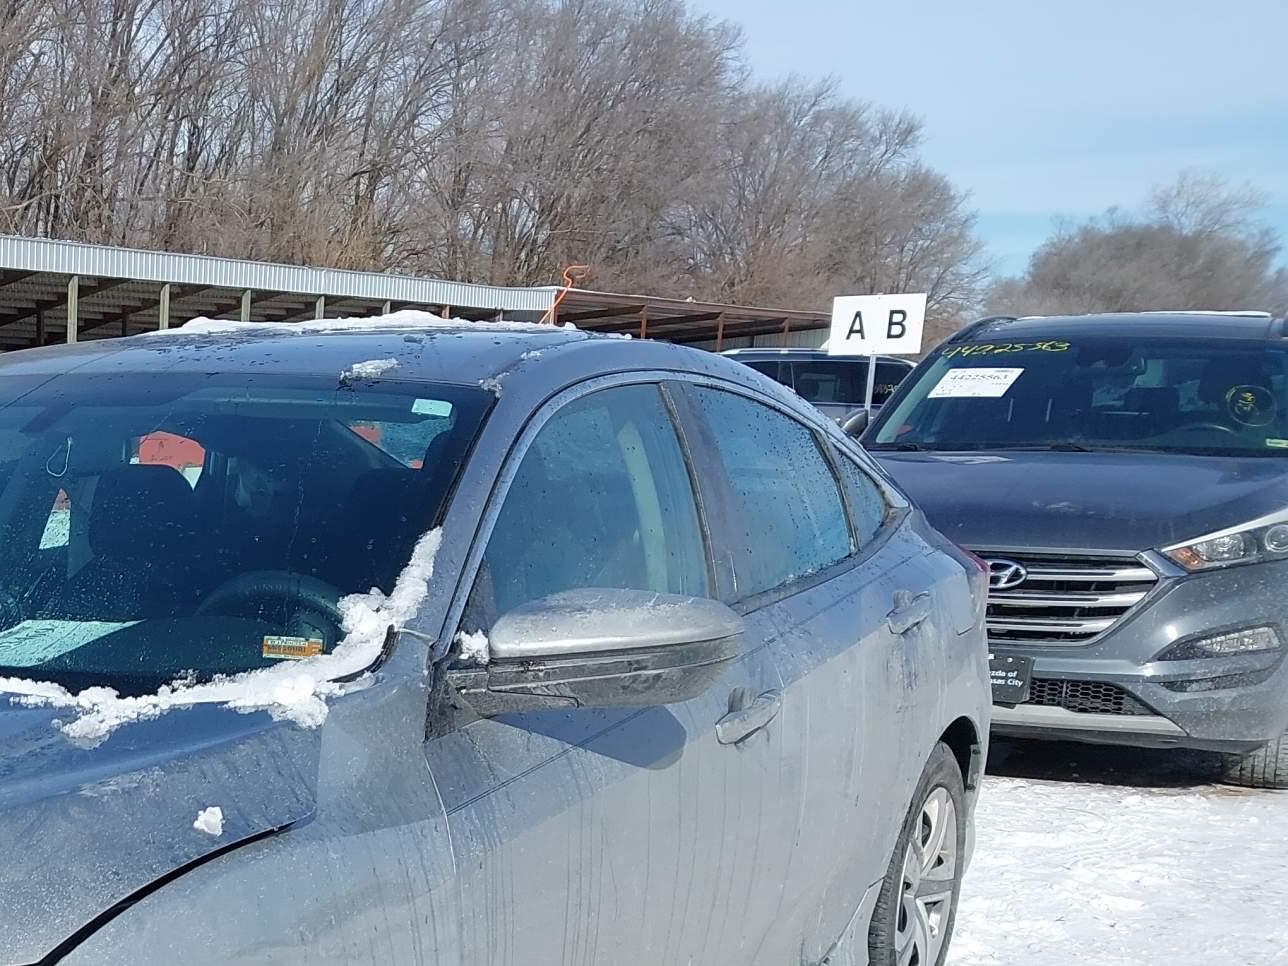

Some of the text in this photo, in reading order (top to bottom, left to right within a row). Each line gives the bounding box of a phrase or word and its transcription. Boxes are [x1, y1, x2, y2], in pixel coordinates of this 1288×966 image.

[845, 309, 907, 341] A B
[941, 340, 1071, 358] 44225563
[1007, 679, 1024, 687] City
